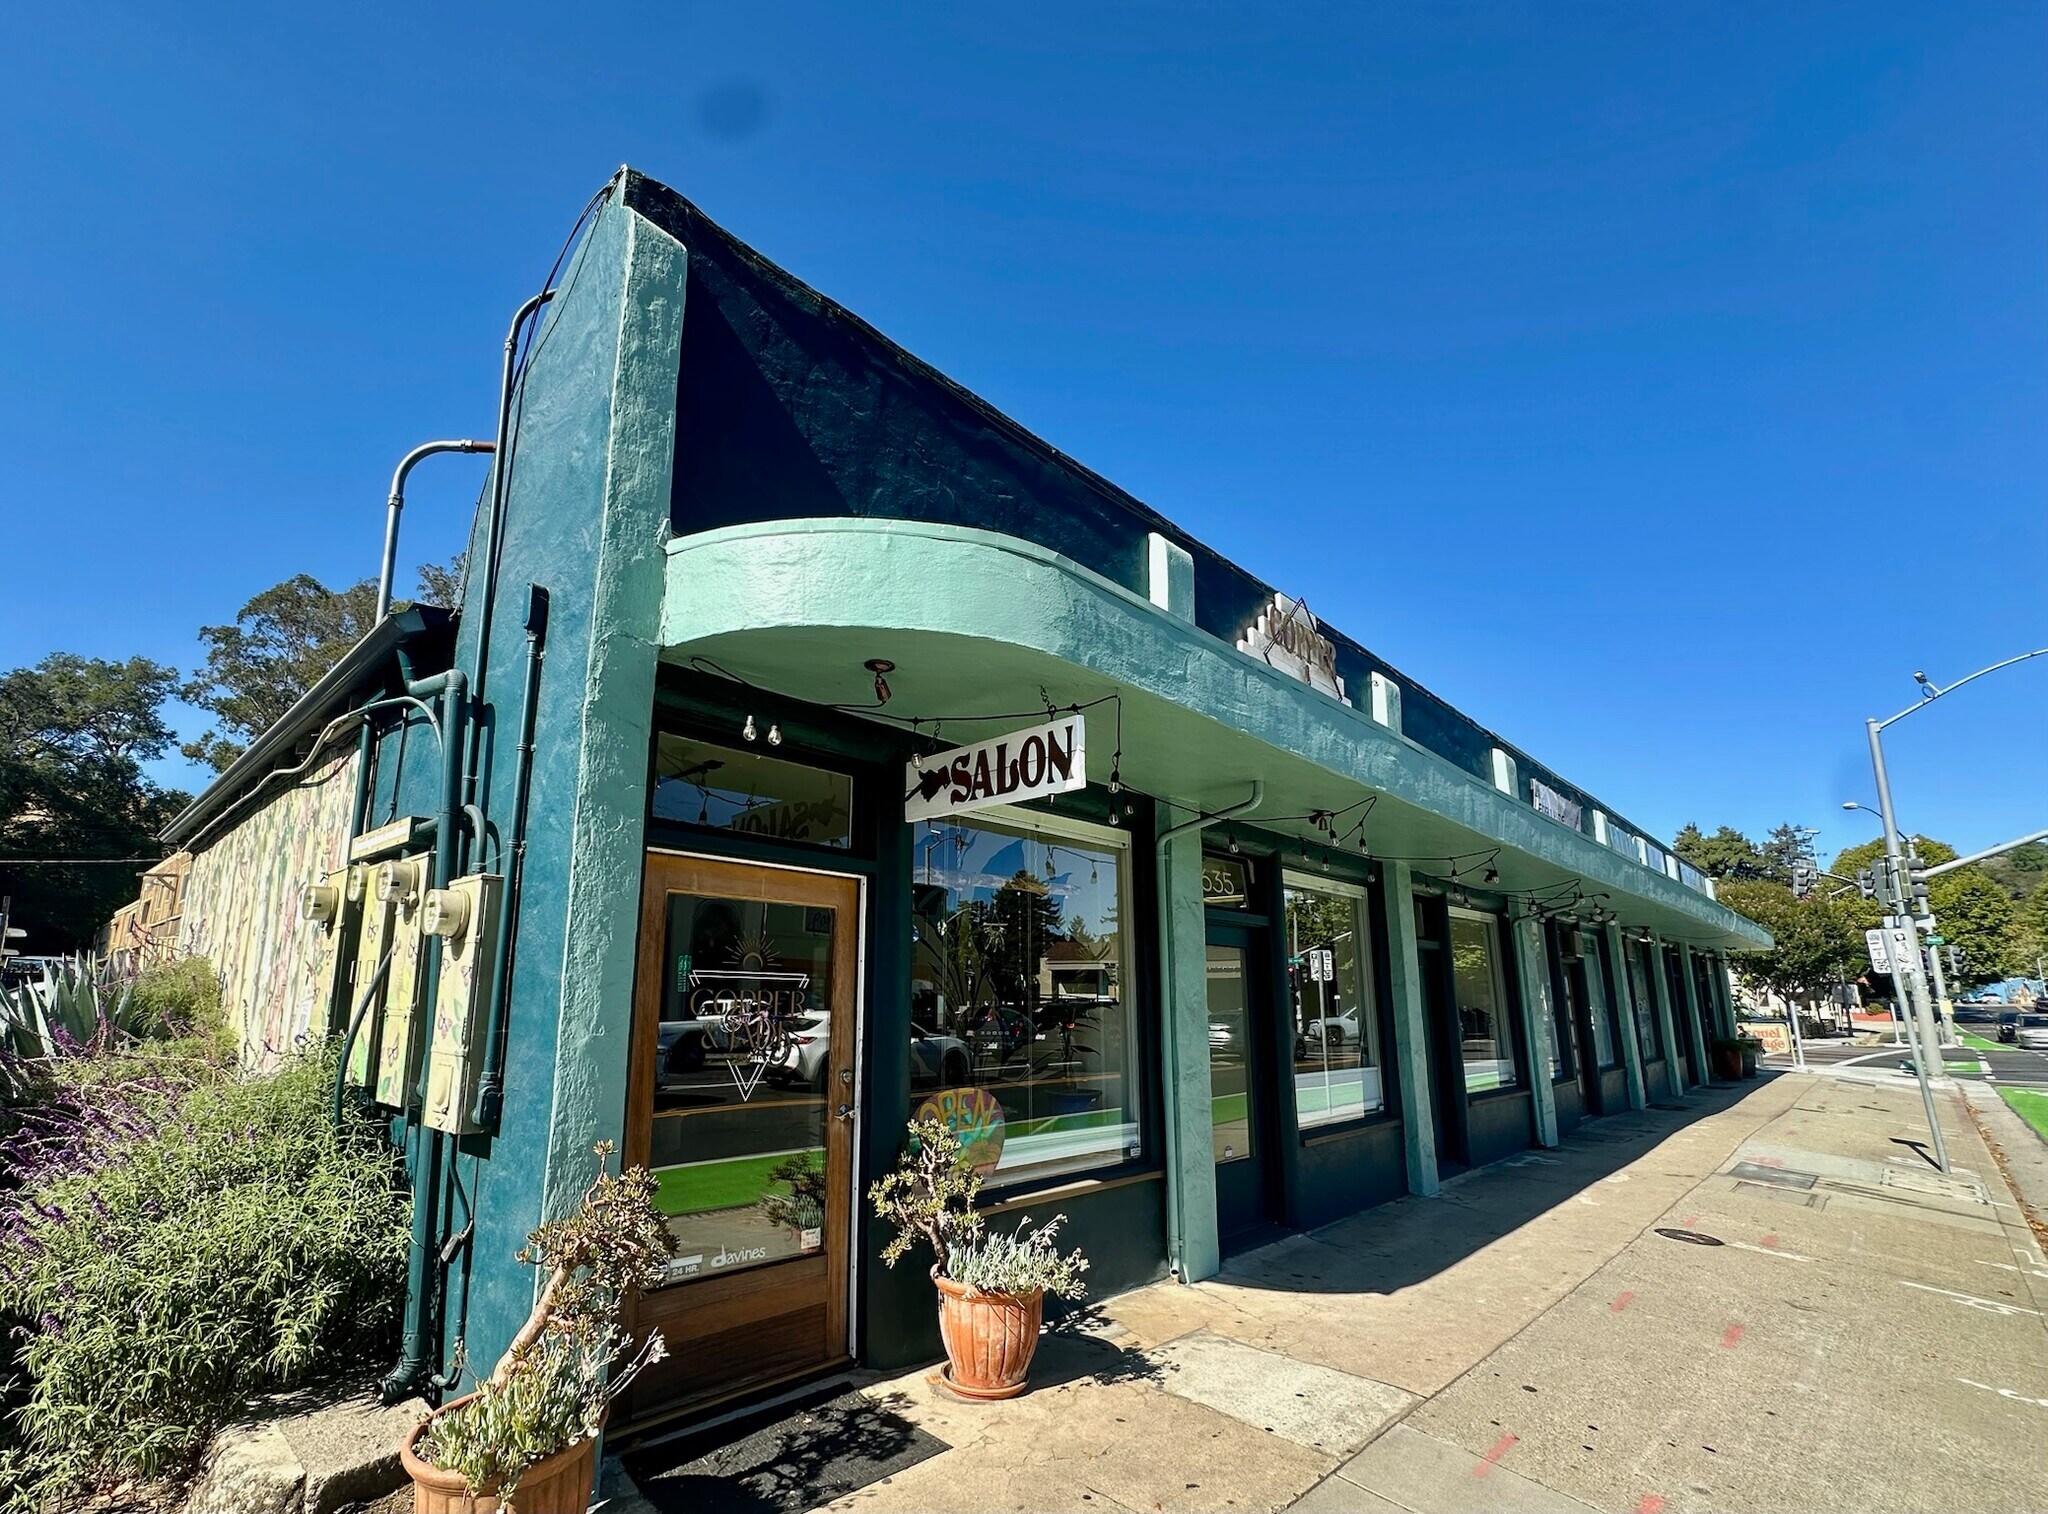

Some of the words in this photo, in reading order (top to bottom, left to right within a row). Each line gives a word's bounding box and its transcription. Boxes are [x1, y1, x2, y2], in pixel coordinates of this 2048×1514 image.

[950, 725, 1074, 805] SALON
[1201, 868, 1235, 895] 635
[690, 988, 806, 1017] COPPER
[700, 1022, 718, 1050] &
[918, 1088, 996, 1133] OPEN
[711, 1243, 766, 1268] davines
[672, 1268, 683, 1276] 24
